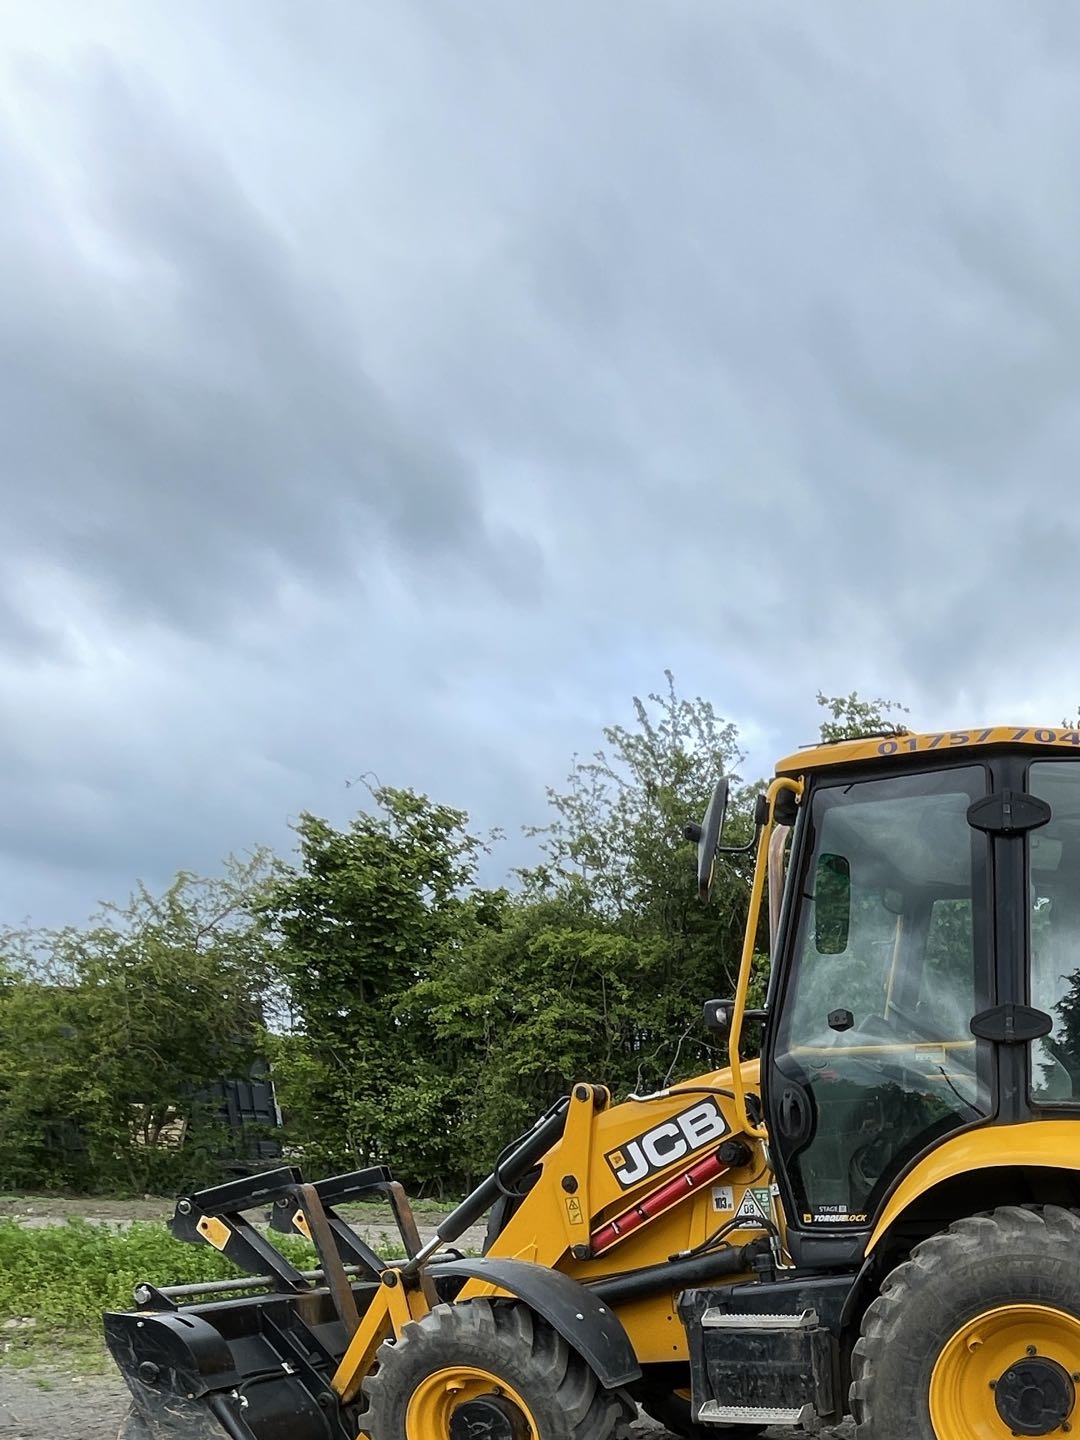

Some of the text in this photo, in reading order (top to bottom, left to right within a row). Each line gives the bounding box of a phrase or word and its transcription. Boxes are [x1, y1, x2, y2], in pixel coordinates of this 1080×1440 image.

[877, 728, 994, 756] 01757
[617, 1102, 726, 1185] JCB
[743, 1204, 755, 1214] 08
[813, 1214, 868, 1222] TORQUELOCK
